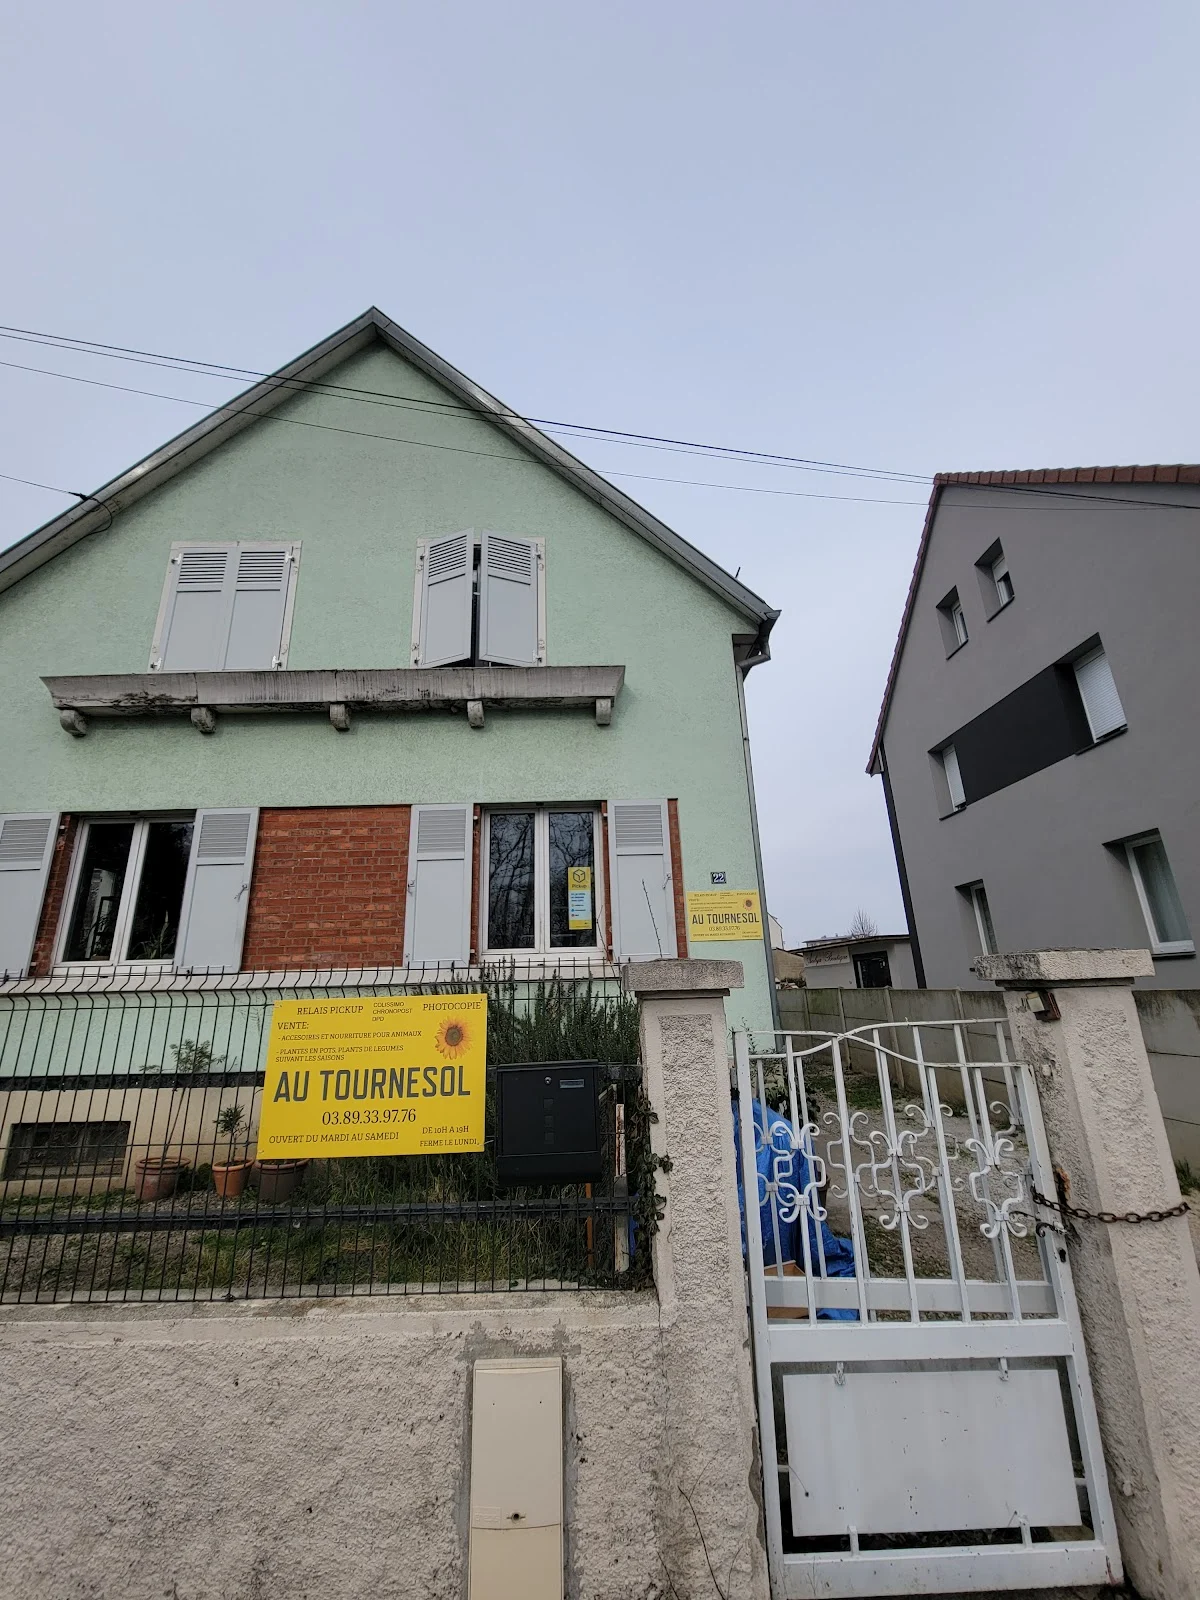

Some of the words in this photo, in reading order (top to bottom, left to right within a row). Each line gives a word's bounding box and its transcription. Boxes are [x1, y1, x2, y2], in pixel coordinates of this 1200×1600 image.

[713, 873, 724, 882] 22
[692, 914, 704, 925] AU
[707, 912, 760, 924] TOURNESOL
[297, 1006, 328, 1015] RELAIS
[330, 1005, 364, 1014] PICKUP
[422, 1001, 481, 1011] PHOTOCOPIE
[277, 1021, 309, 1030] VENTE:
[330, 1032, 371, 1040] NOURRITURE
[273, 1070, 310, 1102] AU
[320, 1065, 471, 1101] TOURNESOL
[322, 1108, 416, 1125] 03.89.33.97.76
[422, 1126, 433, 1134] DE
[456, 1125, 469, 1134] 19H
[268, 1134, 304, 1144] OUVERT
[305, 1134, 319, 1143] DU
[320, 1133, 349, 1142] MARDI
[351, 1133, 364, 1141] AU
[365, 1131, 399, 1141] SAMEDI
[420, 1139, 445, 1147] FERME
